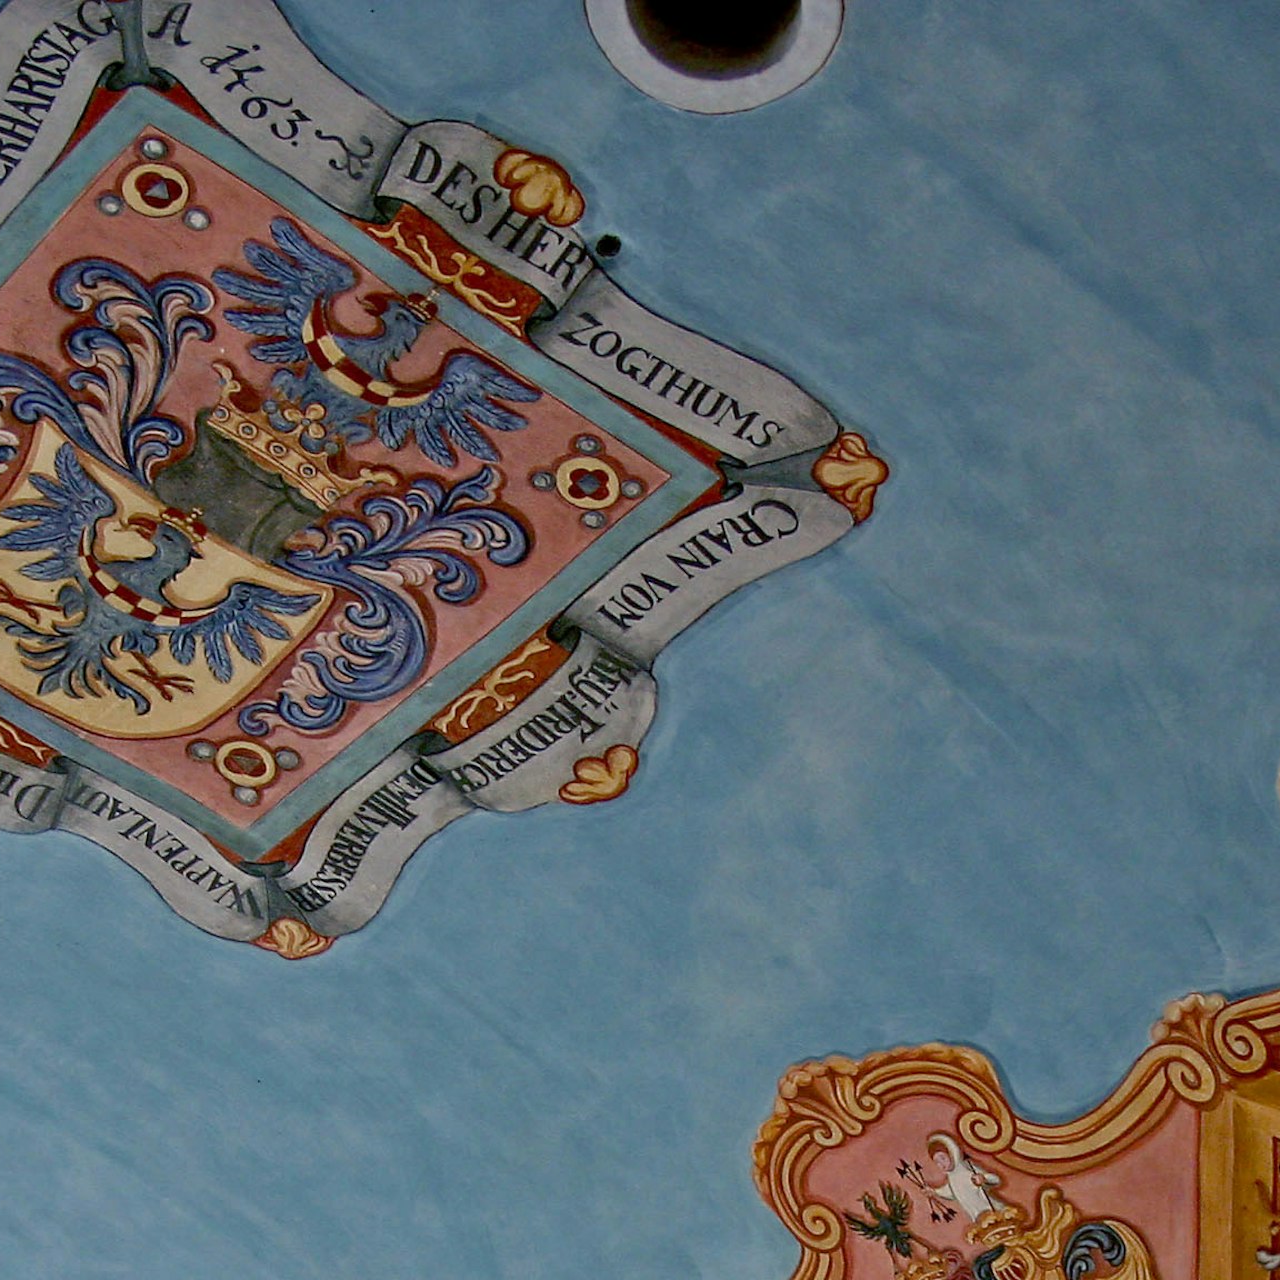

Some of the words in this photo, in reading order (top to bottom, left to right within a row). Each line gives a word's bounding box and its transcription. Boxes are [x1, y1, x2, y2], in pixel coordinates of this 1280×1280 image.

[404, 141, 501, 226] DES
[666, 497, 801, 583] CRAIN
[593, 572, 679, 632] VOM
